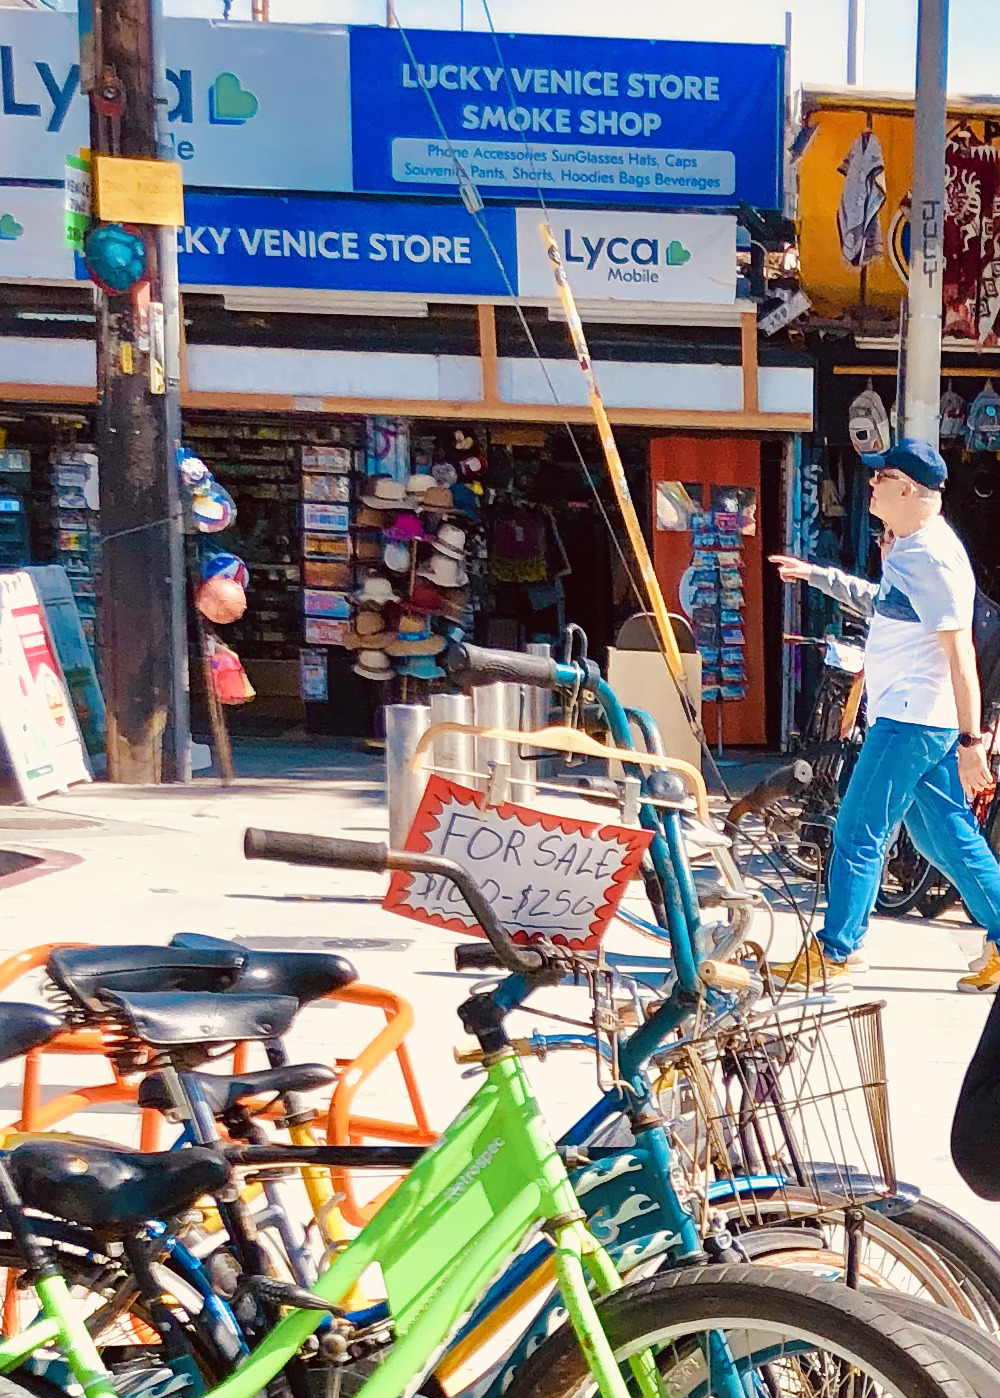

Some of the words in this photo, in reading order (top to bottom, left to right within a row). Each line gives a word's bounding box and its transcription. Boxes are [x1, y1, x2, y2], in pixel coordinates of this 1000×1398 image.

[0, 45, 194, 133] Lya
[402, 63, 504, 92] LUCKY
[510, 67, 619, 98] VENICE
[627, 73, 720, 101] STORE
[462, 105, 572, 134] SMOKE
[579, 109, 662, 137] SHOP
[427, 144, 470, 161] Phone
[473, 147, 547, 163] Accessories
[551, 150, 624, 166] SunGlasses
[628, 153, 660, 168] Hats,
[665, 154, 698, 171] Caps
[561, 169, 615, 185] Hoodies
[619, 172, 651, 188] Bags
[655, 173, 721, 190] Beverages
[238, 230, 359, 261] VENICE
[369, 233, 471, 266] STORE
[564, 229, 660, 270] Lyca
[607, 266, 660, 284] Mobile
[440, 812, 526, 867] FOR
[533, 835, 620, 880] SALE
